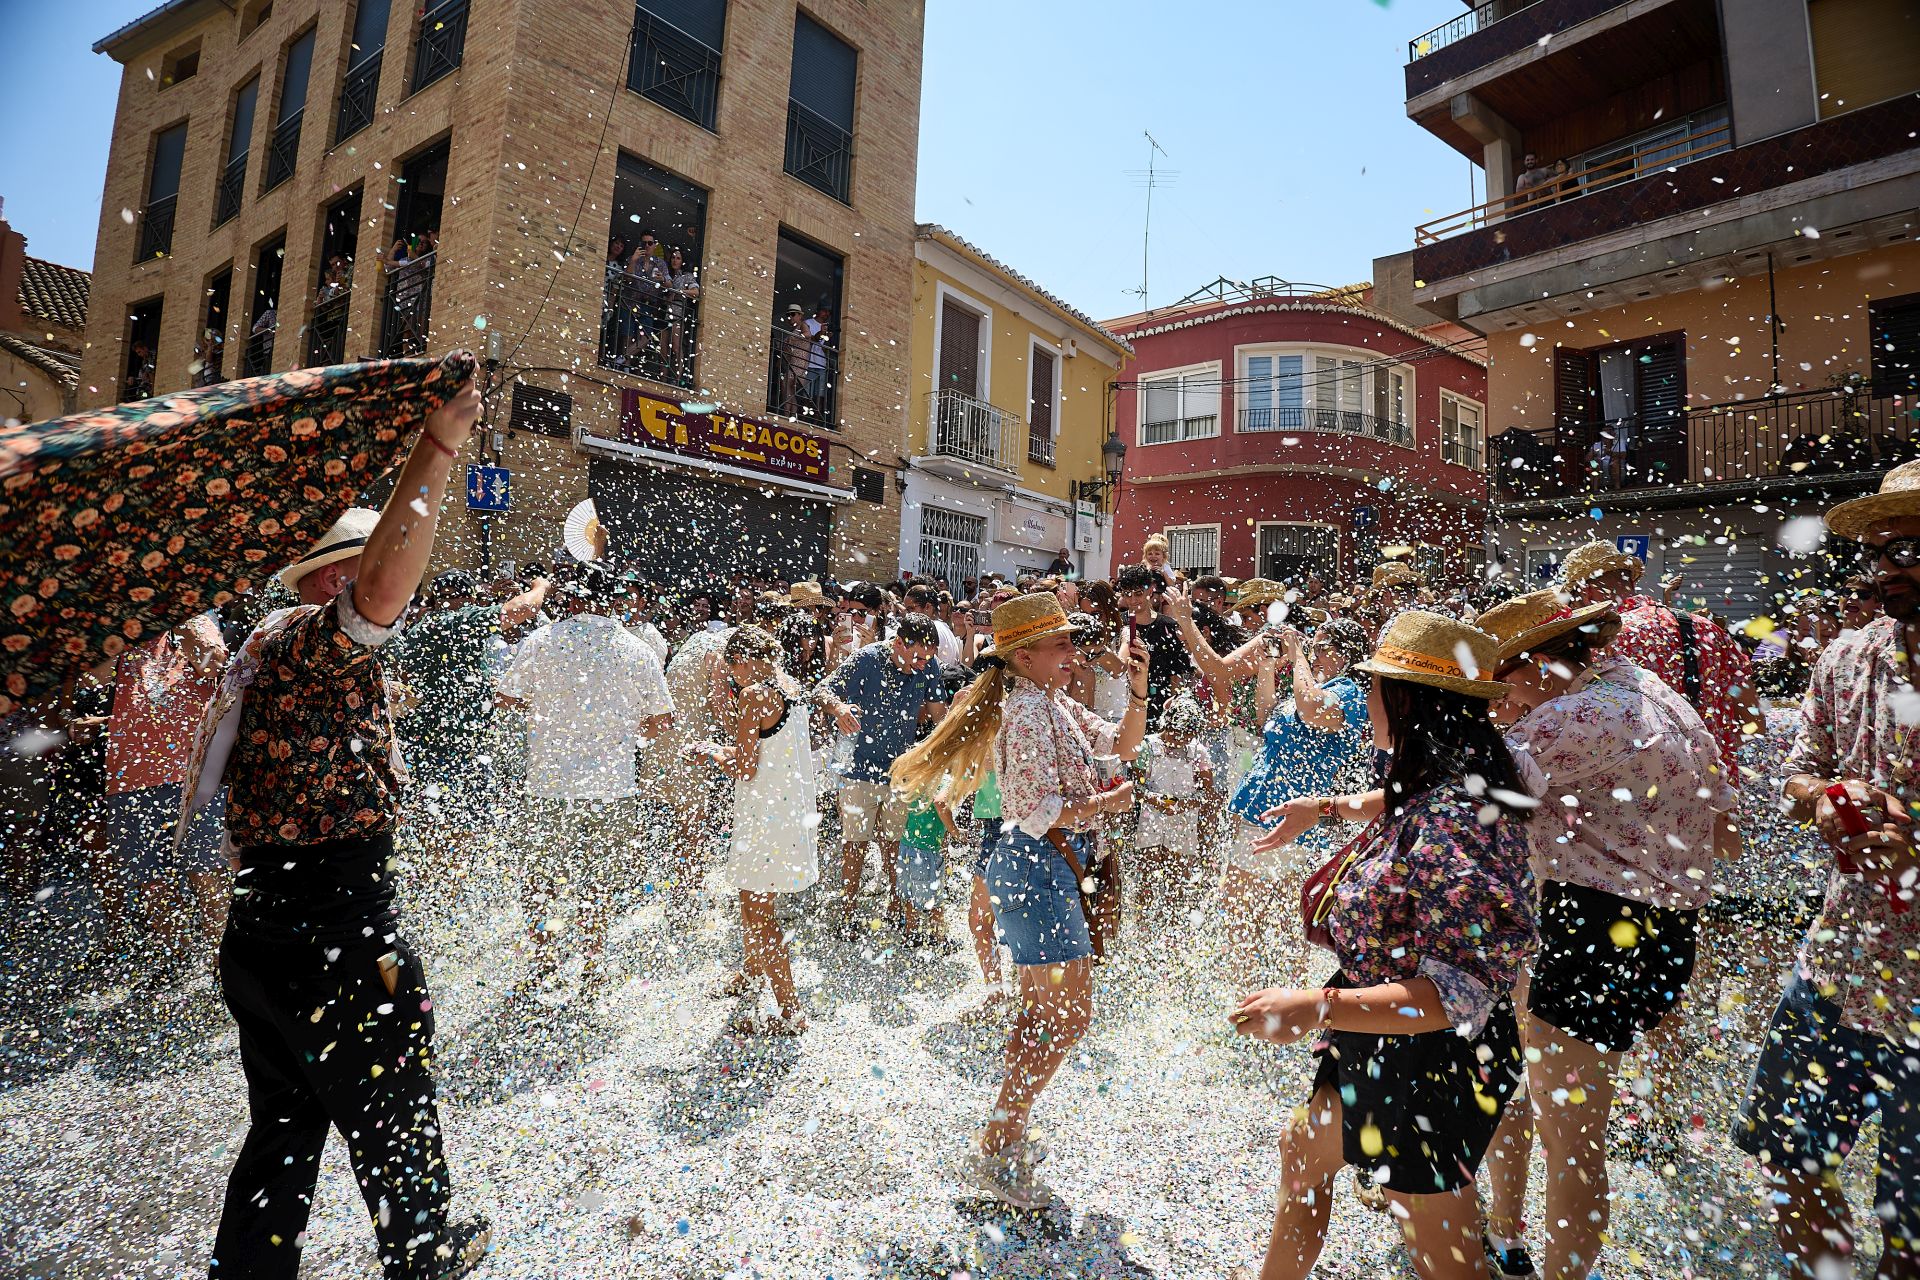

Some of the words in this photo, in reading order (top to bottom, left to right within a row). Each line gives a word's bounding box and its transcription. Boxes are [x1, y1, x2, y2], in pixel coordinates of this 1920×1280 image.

[709, 414, 819, 458] TABACOS
[770, 457, 786, 467] EXP
[1411, 656, 1444, 673] Fadrina
